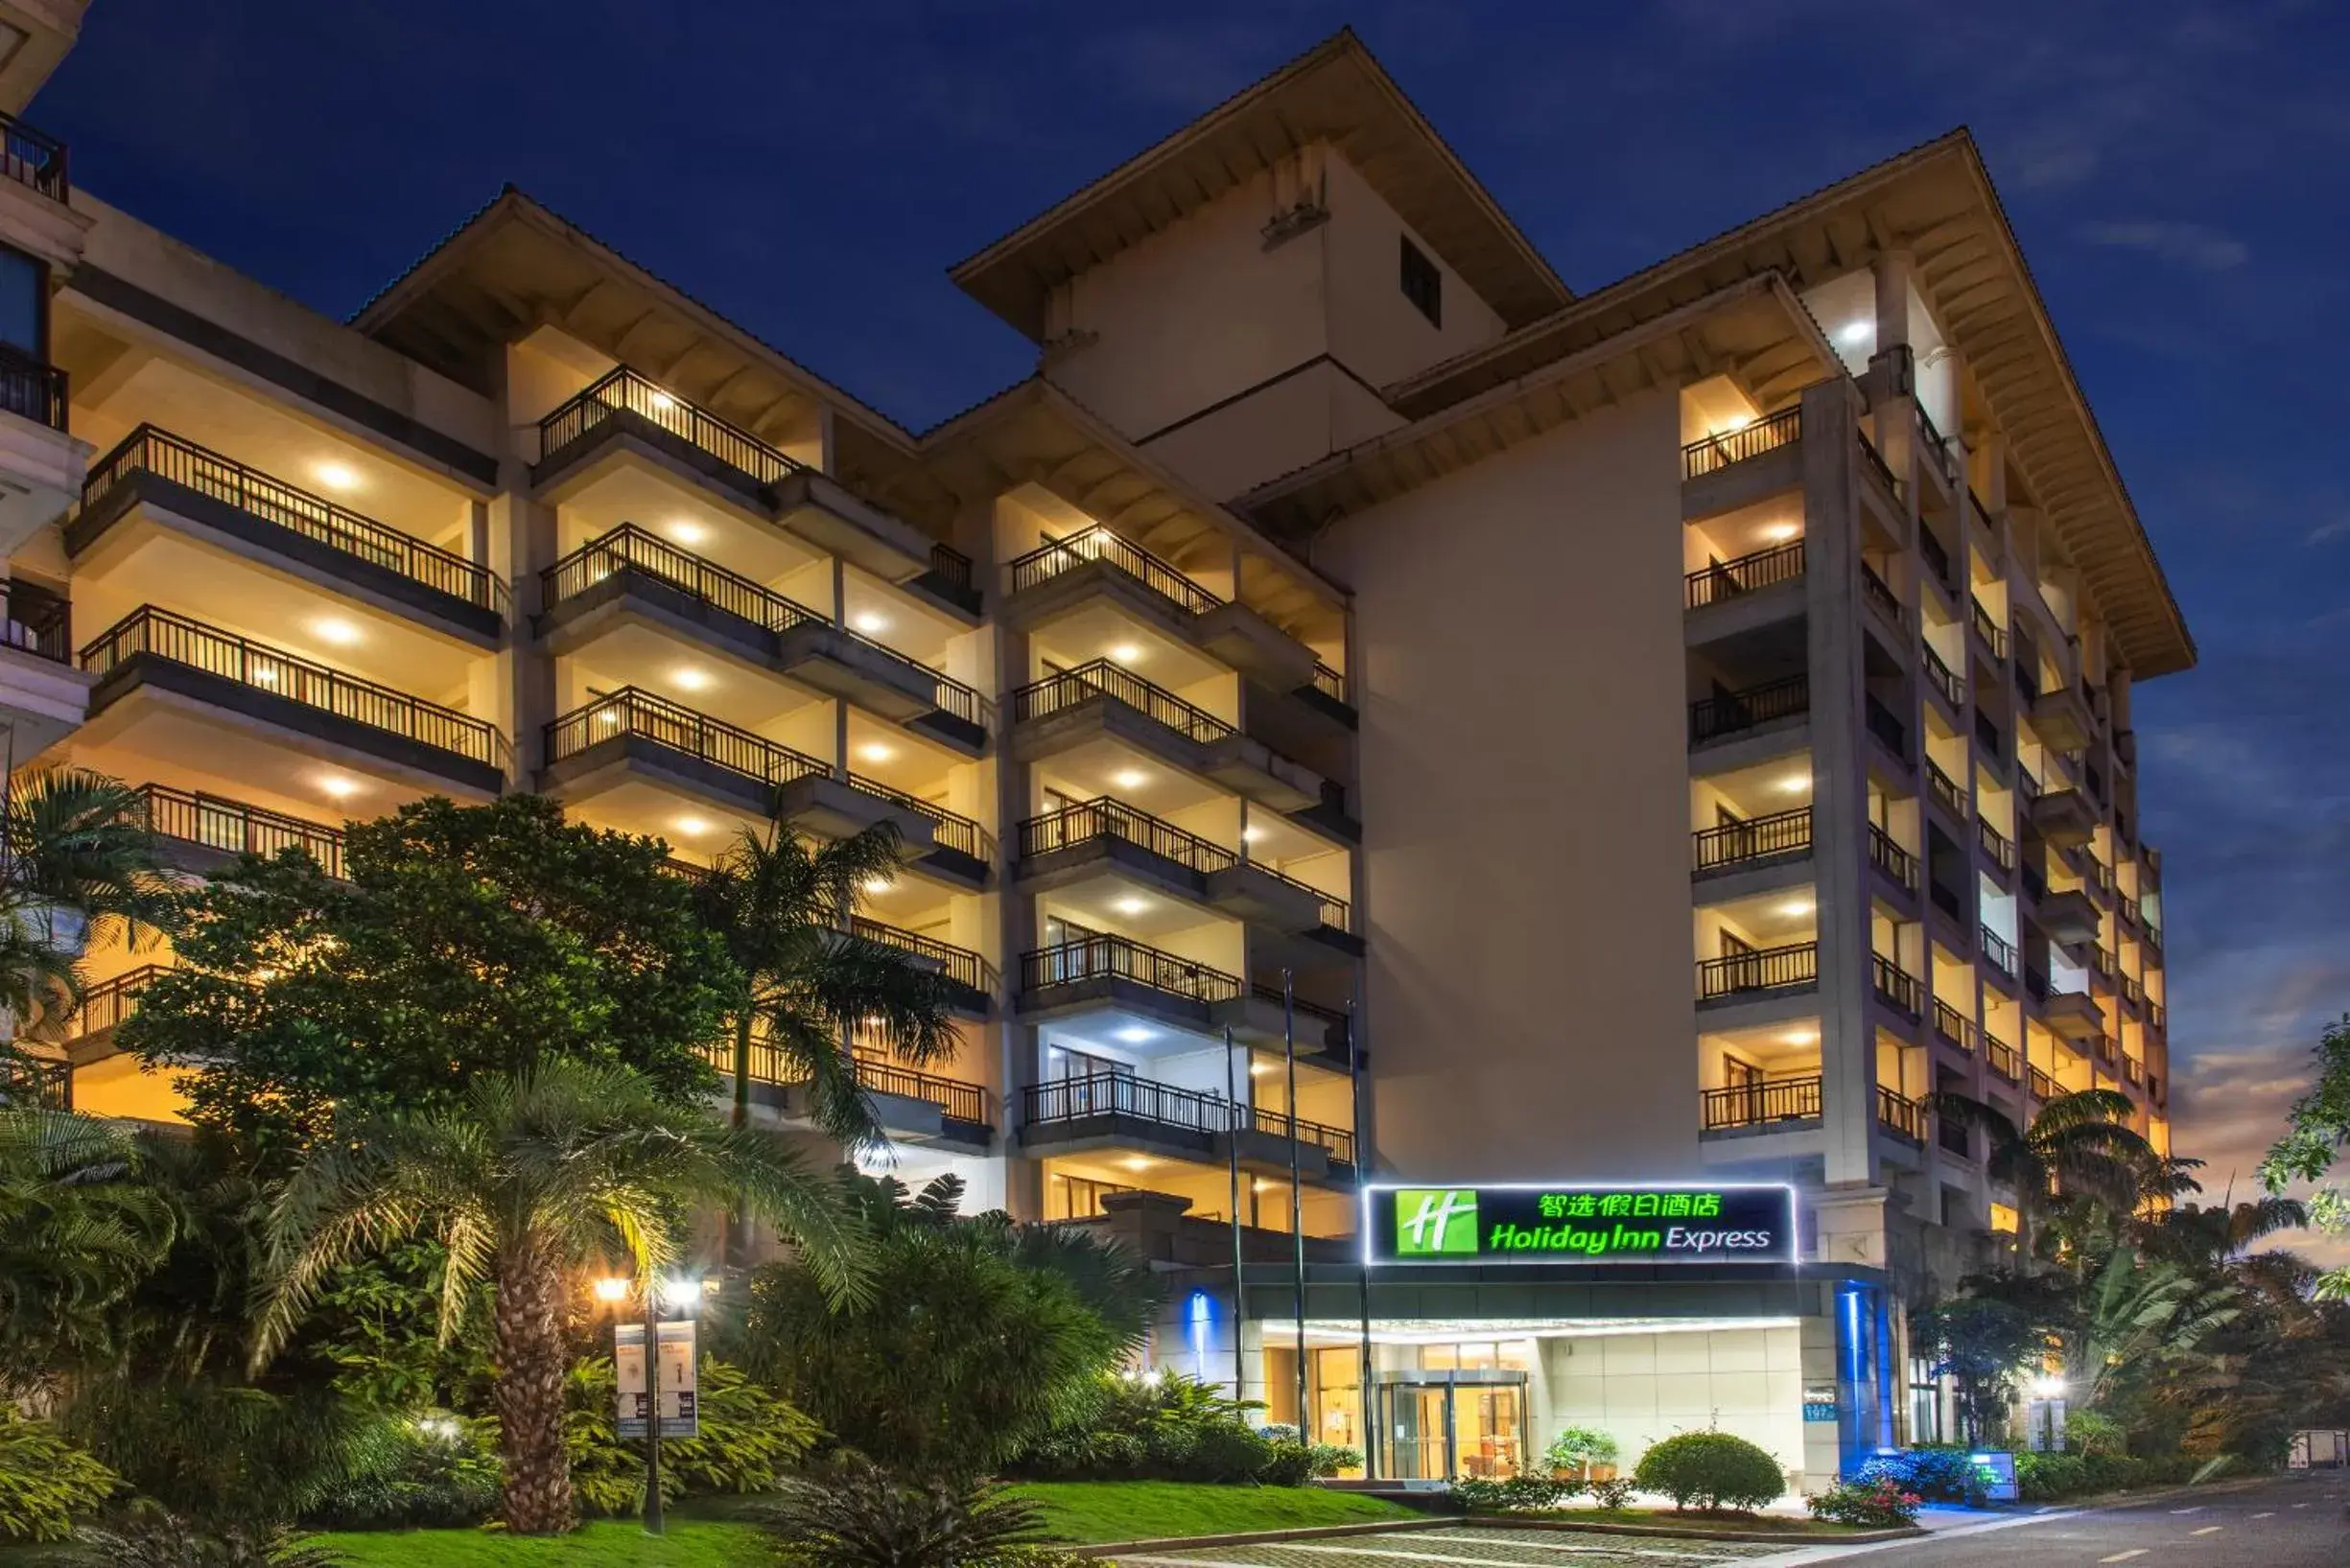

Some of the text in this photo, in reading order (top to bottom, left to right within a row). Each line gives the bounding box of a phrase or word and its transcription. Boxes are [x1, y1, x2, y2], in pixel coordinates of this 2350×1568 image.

[1539, 1193, 1721, 1217] 智选假日酒店
[1491, 1224, 1771, 1253] Holiday Inn Express
